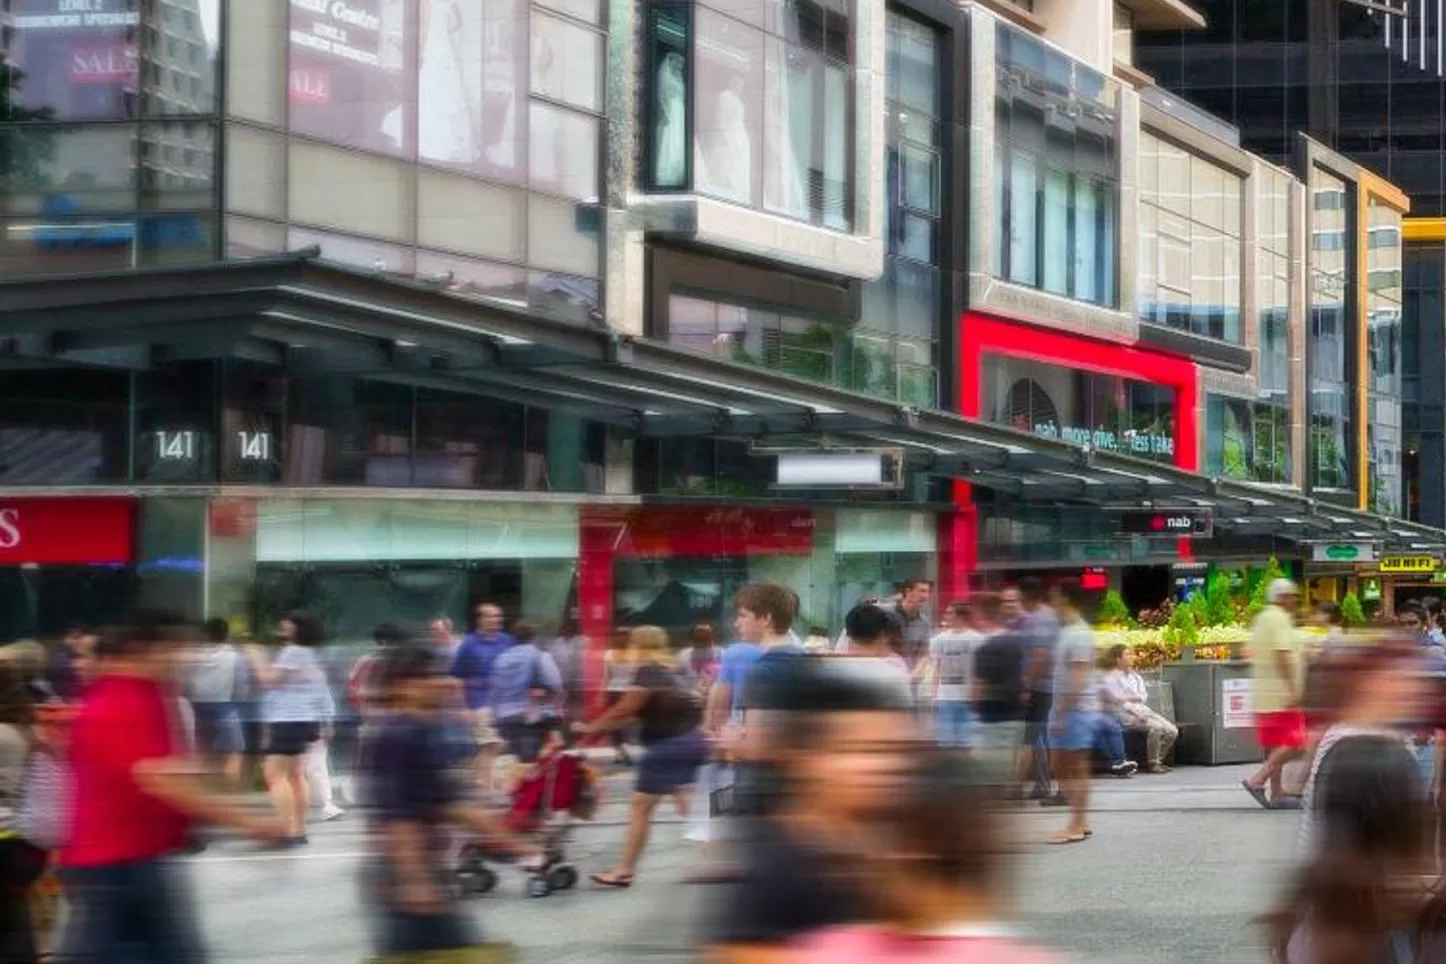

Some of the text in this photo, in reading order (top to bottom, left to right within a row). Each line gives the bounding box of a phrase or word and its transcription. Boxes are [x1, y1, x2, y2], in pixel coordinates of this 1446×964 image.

[156, 432, 193, 458] 141
[238, 432, 269, 459] 141
[1167, 516, 1191, 527] nab
